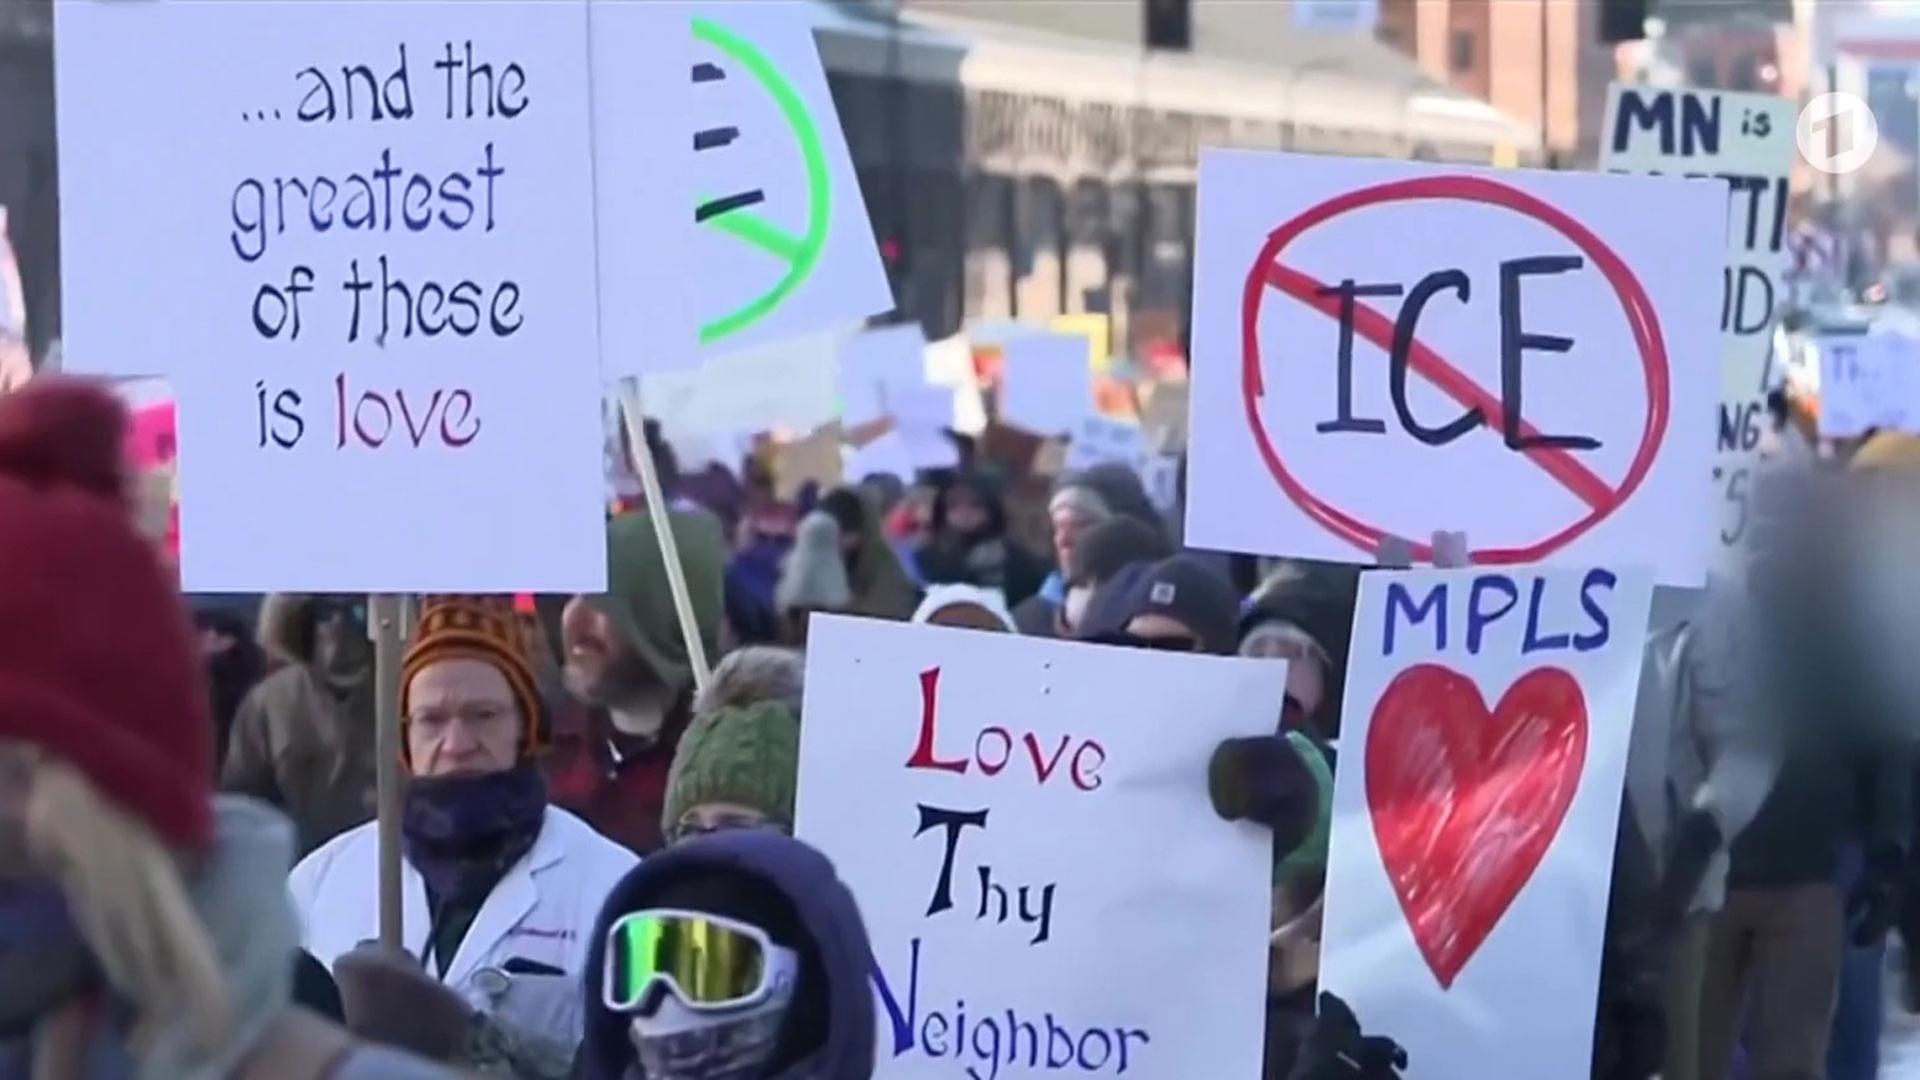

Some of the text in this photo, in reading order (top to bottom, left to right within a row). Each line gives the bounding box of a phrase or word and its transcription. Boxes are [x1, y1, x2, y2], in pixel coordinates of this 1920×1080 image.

[434, 40, 529, 119] the
[1612, 90, 1772, 157] MN is
[230, 143, 505, 262] greatest
[251, 254, 524, 348] of these
[1316, 255, 1602, 452] ICE
[256, 372, 481, 449] is love
[1382, 567, 1617, 657] MPLS
[905, 665, 1106, 792] Love
[912, 803, 1057, 945] Thy
